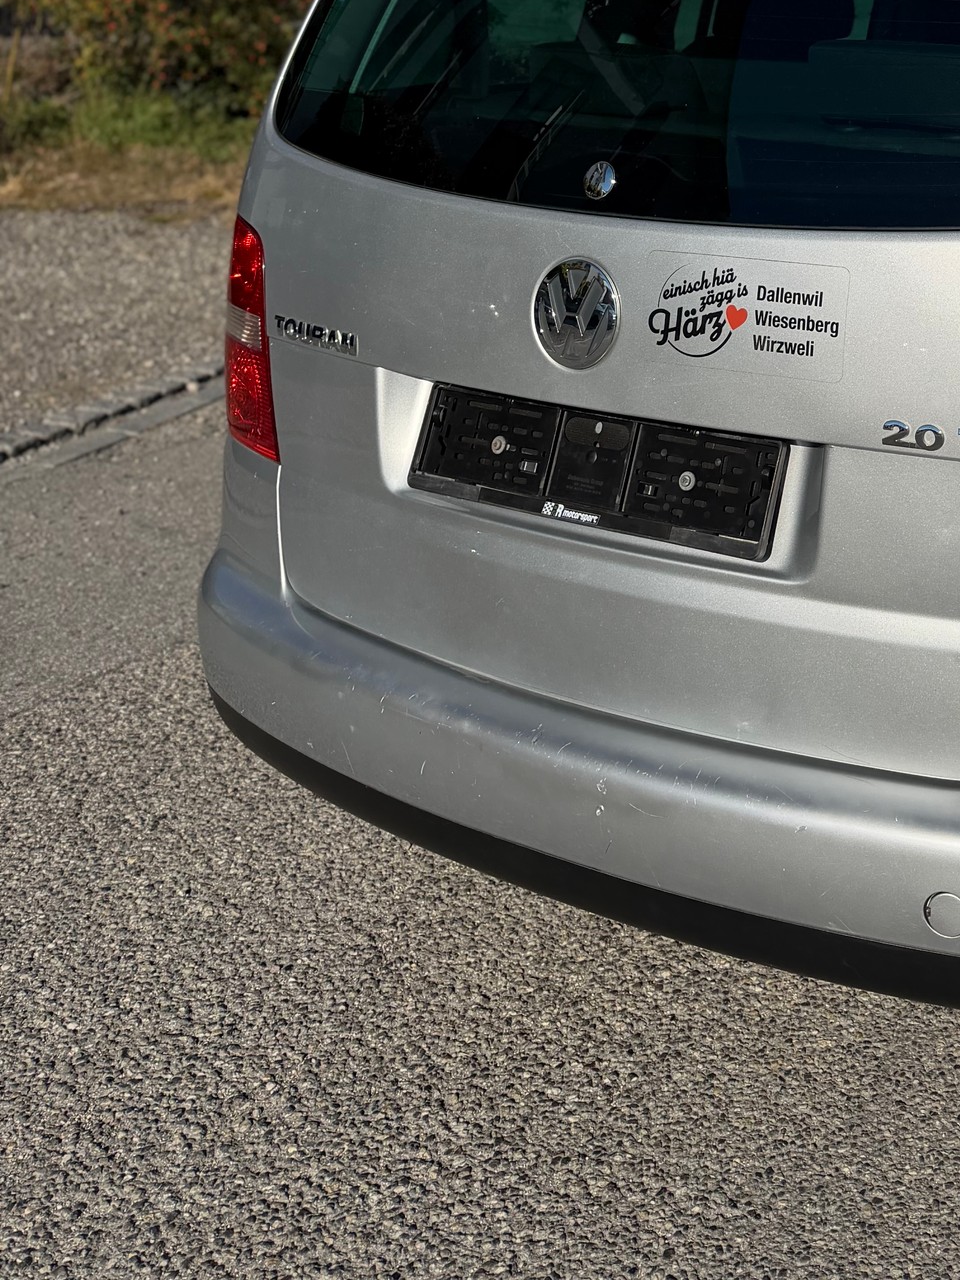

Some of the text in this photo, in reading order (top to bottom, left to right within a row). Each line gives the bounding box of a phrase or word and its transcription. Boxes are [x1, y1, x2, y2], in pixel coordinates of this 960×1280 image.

[662, 267, 737, 300] einisch hiä
[699, 282, 749, 313] zägg is
[756, 285, 824, 308] Dallenwil
[274, 314, 359, 357] TOURAN
[648, 306, 727, 346] Härz
[754, 309, 840, 337] Wiesenberg
[752, 334, 815, 357] Wirzweli
[562, 509, 599, 523] motorsport
